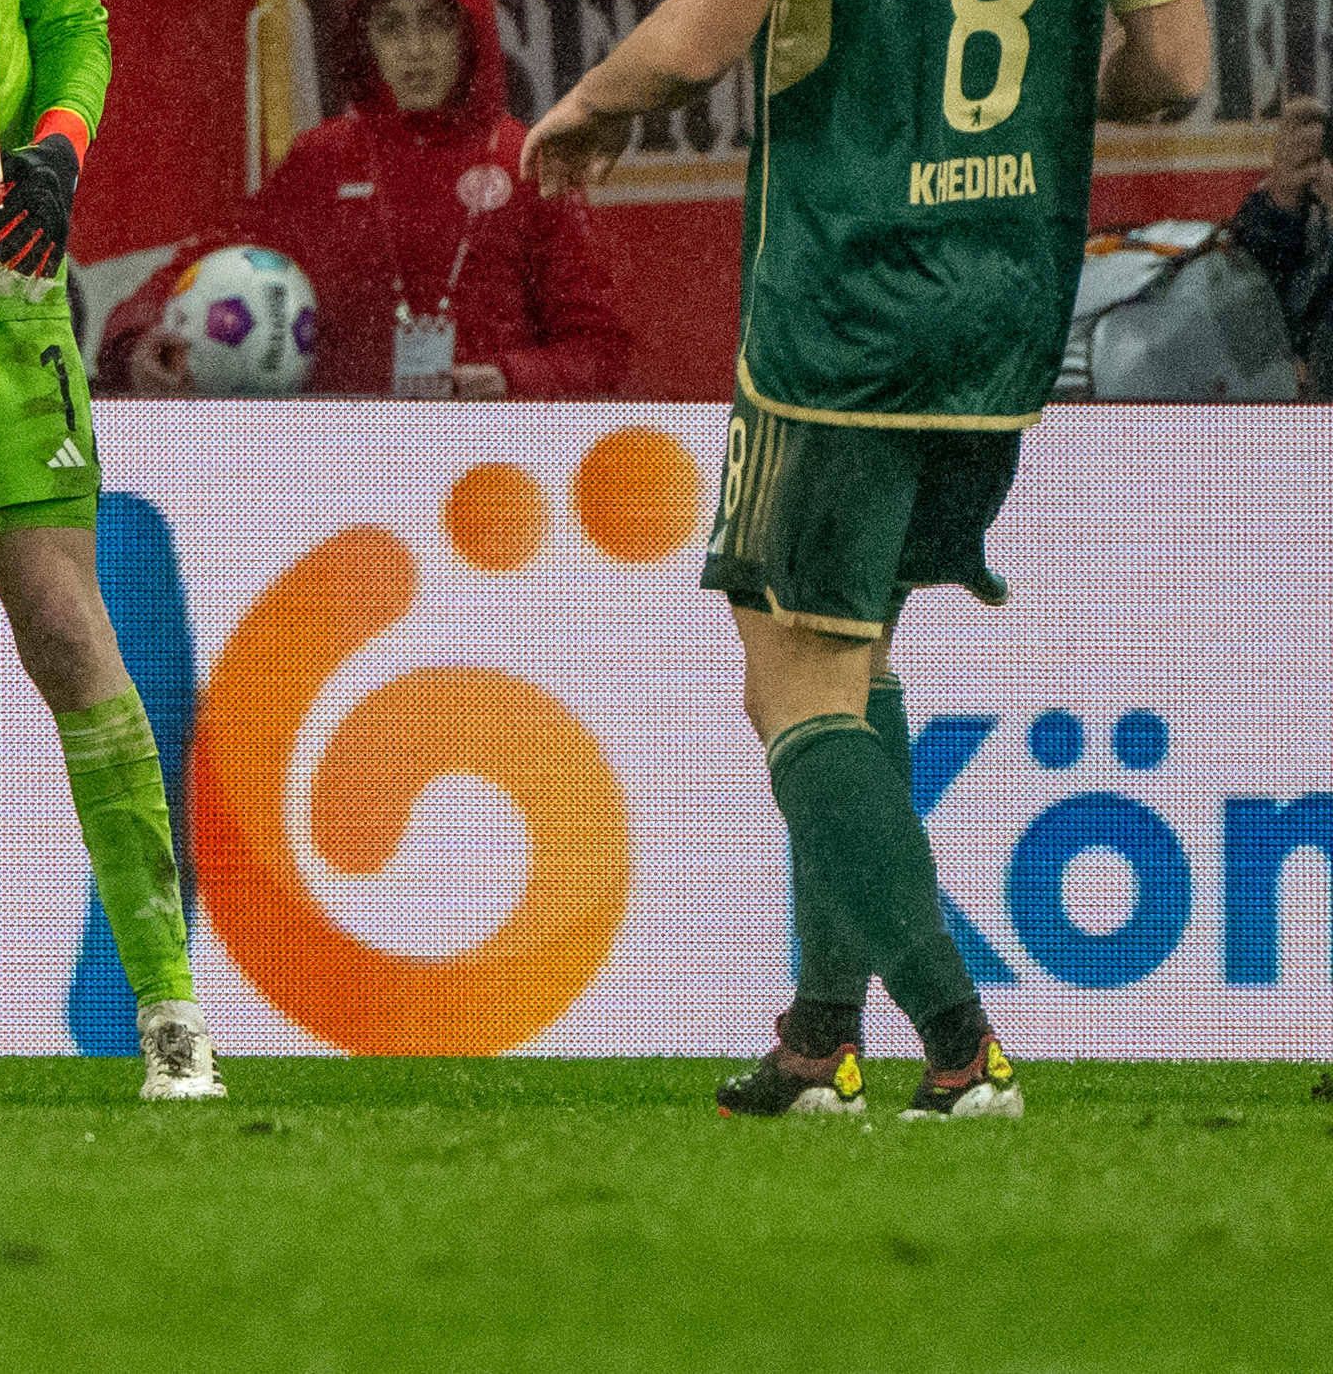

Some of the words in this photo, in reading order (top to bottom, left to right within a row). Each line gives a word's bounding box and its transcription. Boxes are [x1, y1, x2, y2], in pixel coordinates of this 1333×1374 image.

[909, 152, 1037, 206] KHEDIRA
[40, 344, 77, 432] 1
[724, 416, 747, 521] 8
